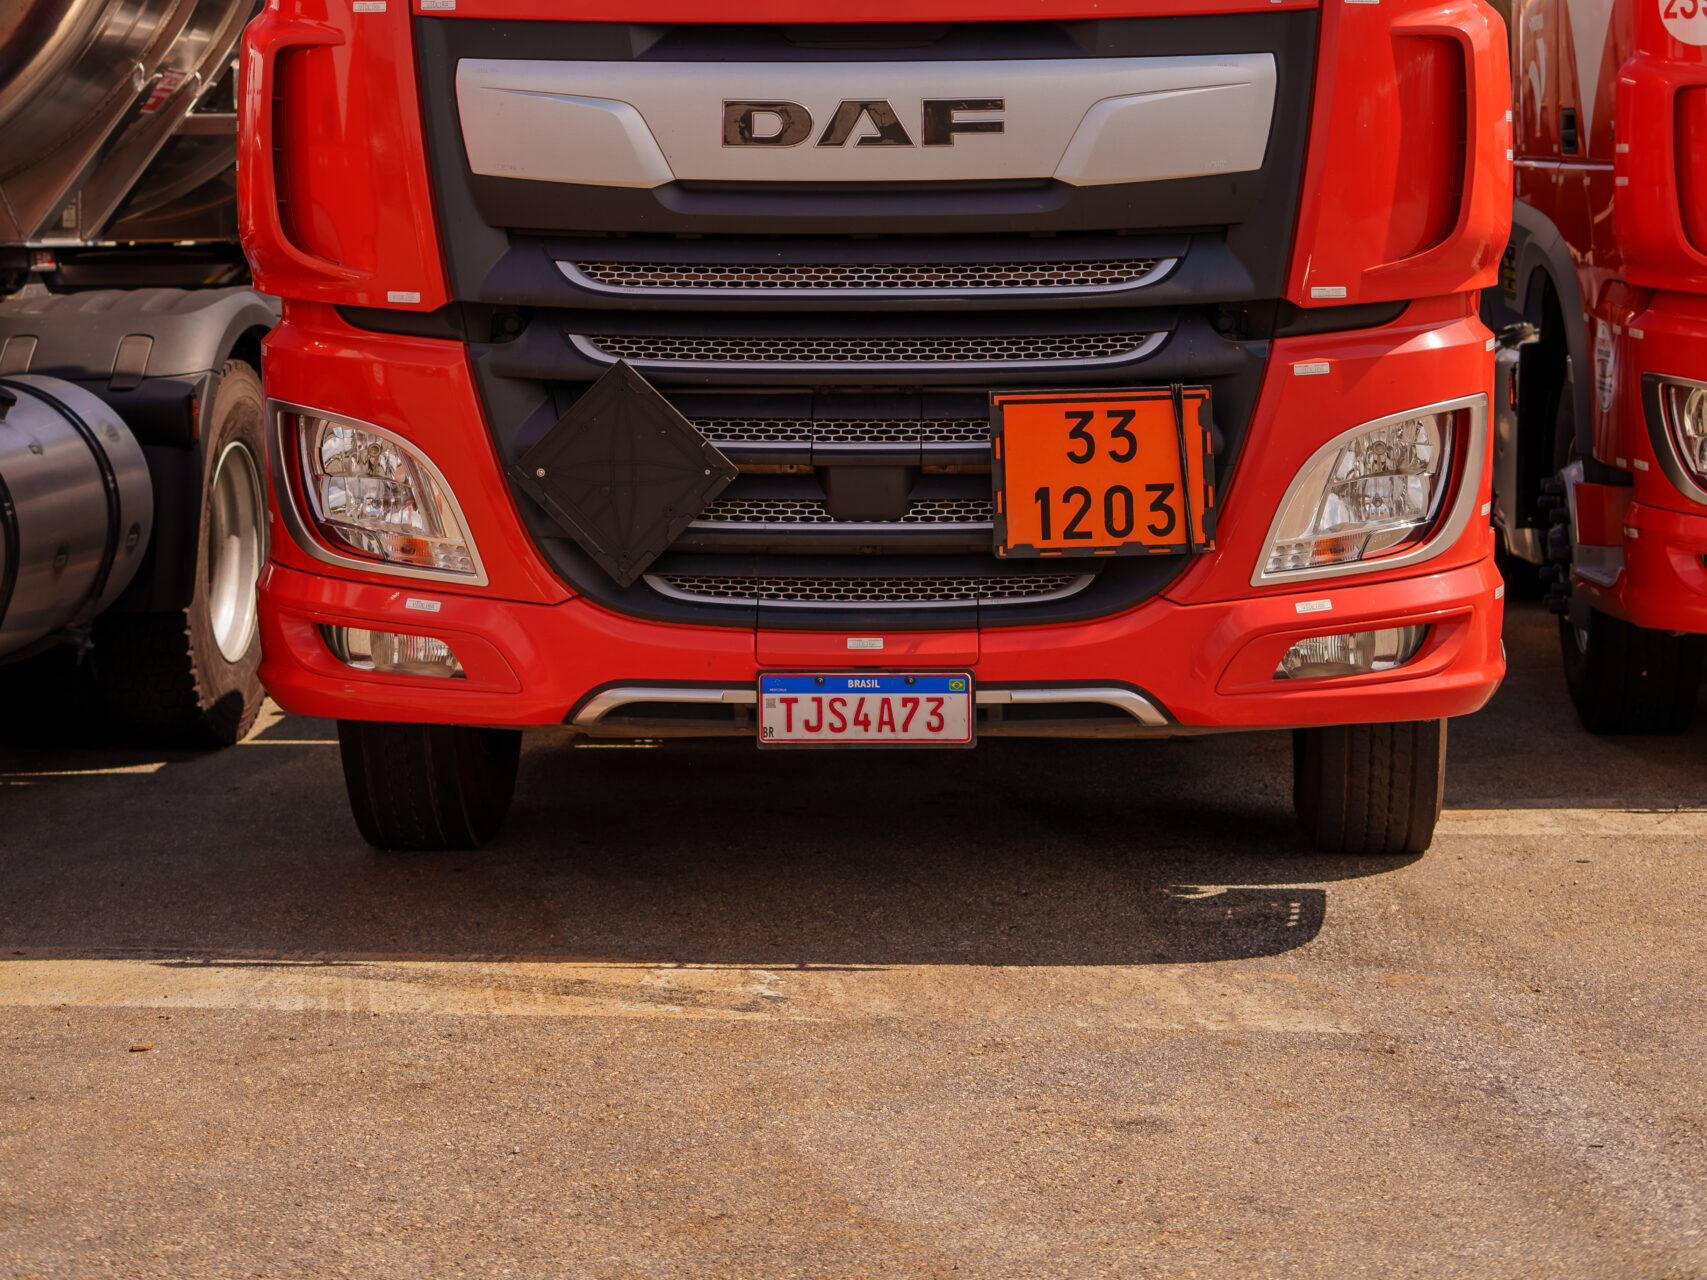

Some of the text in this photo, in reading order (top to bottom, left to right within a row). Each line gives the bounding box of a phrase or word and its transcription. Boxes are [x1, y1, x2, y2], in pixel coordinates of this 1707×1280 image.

[721, 96, 1006, 149] DAF
[1064, 408, 1138, 464] 33
[1034, 482, 1177, 541] 1203
[847, 679, 881, 689] BRASIL
[762, 726, 774, 738] BR
[779, 697, 945, 733] TJS4A73
